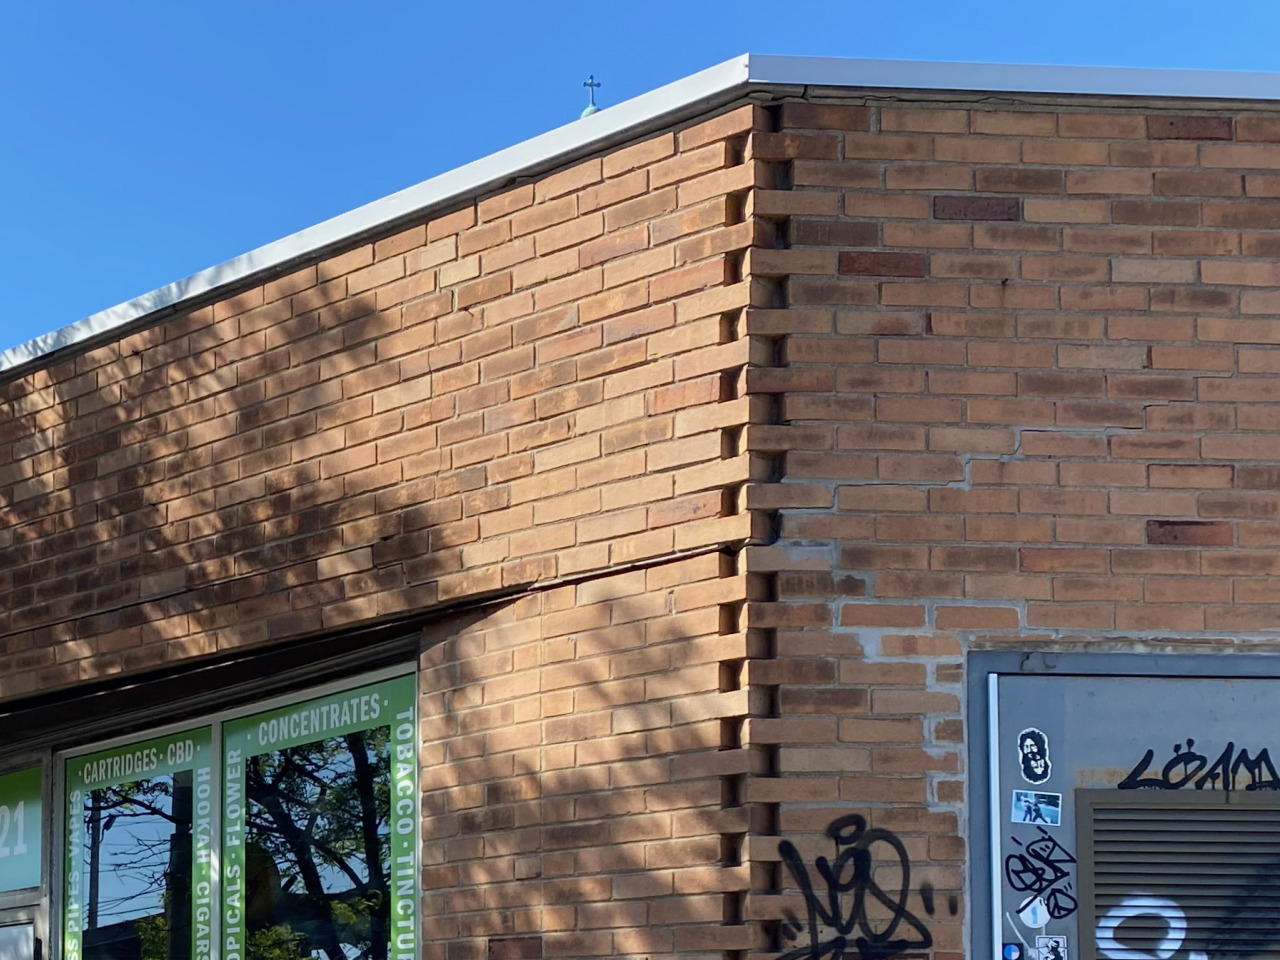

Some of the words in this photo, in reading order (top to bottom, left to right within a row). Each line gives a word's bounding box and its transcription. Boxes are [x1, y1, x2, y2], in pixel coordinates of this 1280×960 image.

[258, 693, 380, 746] CONCENTRATES
[83, 747, 157, 785] CARTRIDGES
[167, 739, 194, 766] CBD
[395, 706, 415, 836] TOBACCO
[68, 789, 81, 858] VAPES
[196, 767, 211, 864] HOOKAH
[226, 749, 241, 846] FLOWER
[67, 871, 80, 933] PIPES
